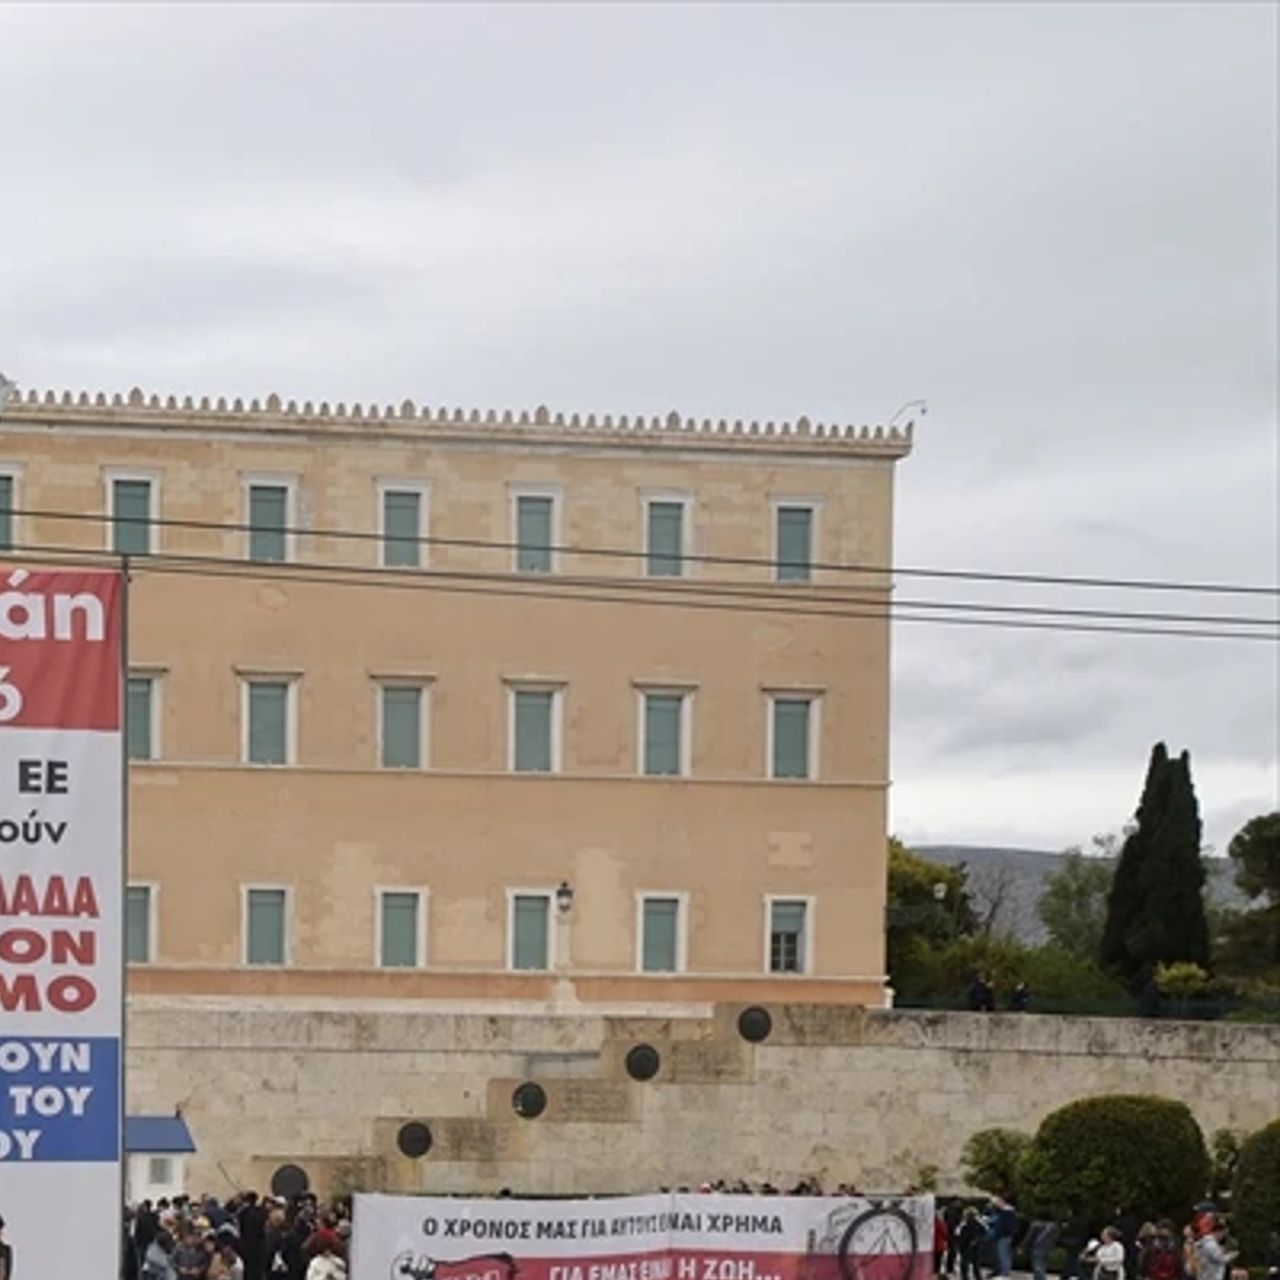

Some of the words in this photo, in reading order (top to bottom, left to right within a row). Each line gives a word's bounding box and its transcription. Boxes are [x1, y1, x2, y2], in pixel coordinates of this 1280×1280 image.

[18, 760, 68, 794] ΕΕ
[9, 1086, 93, 1115] ΤΟΥ
[444, 1219, 531, 1239] ΧΡΟΝΟΣ
[537, 1221, 577, 1239] ΜΑΣ
[582, 1219, 606, 1238] ΓΙΑ
[707, 1214, 783, 1233] ΧΡΗΜΑ
[678, 1258, 695, 1279] Η
